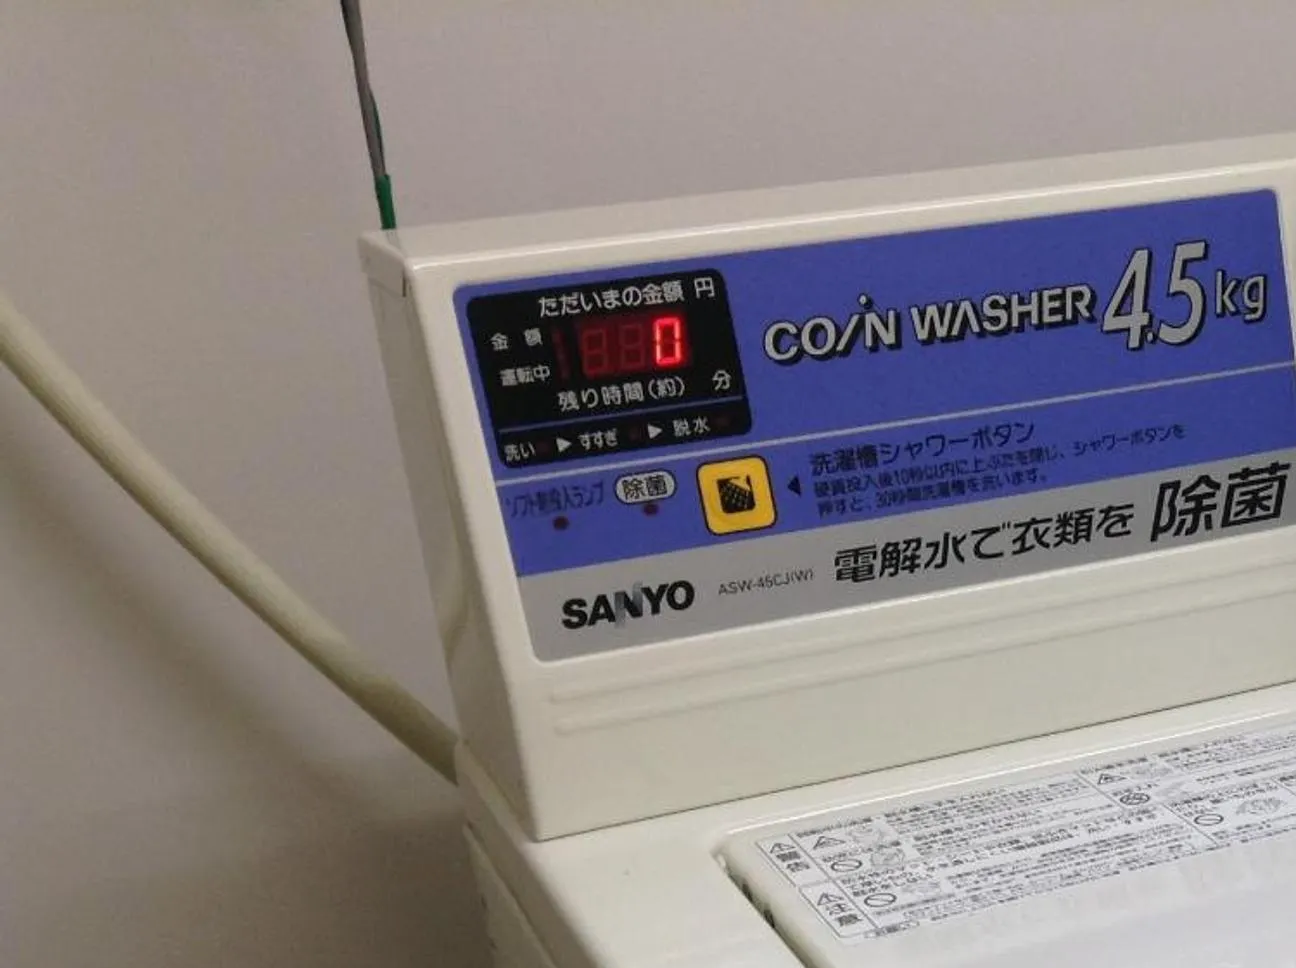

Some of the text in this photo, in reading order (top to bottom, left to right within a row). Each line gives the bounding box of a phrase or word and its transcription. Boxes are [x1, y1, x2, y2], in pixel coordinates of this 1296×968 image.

[538, 277, 716, 318] ただいまの金額 円
[653, 316, 684, 366] 0
[763, 294, 900, 364] COIN
[911, 284, 1094, 345] WASHER
[712, 369, 732, 391] 分
[504, 416, 711, 463] 洗い すすぎ 脱水
[622, 475, 668, 500] 除菌
[833, 462, 1290, 584] 電解水で衣類を 除菌
[562, 579, 696, 629] SANYO
